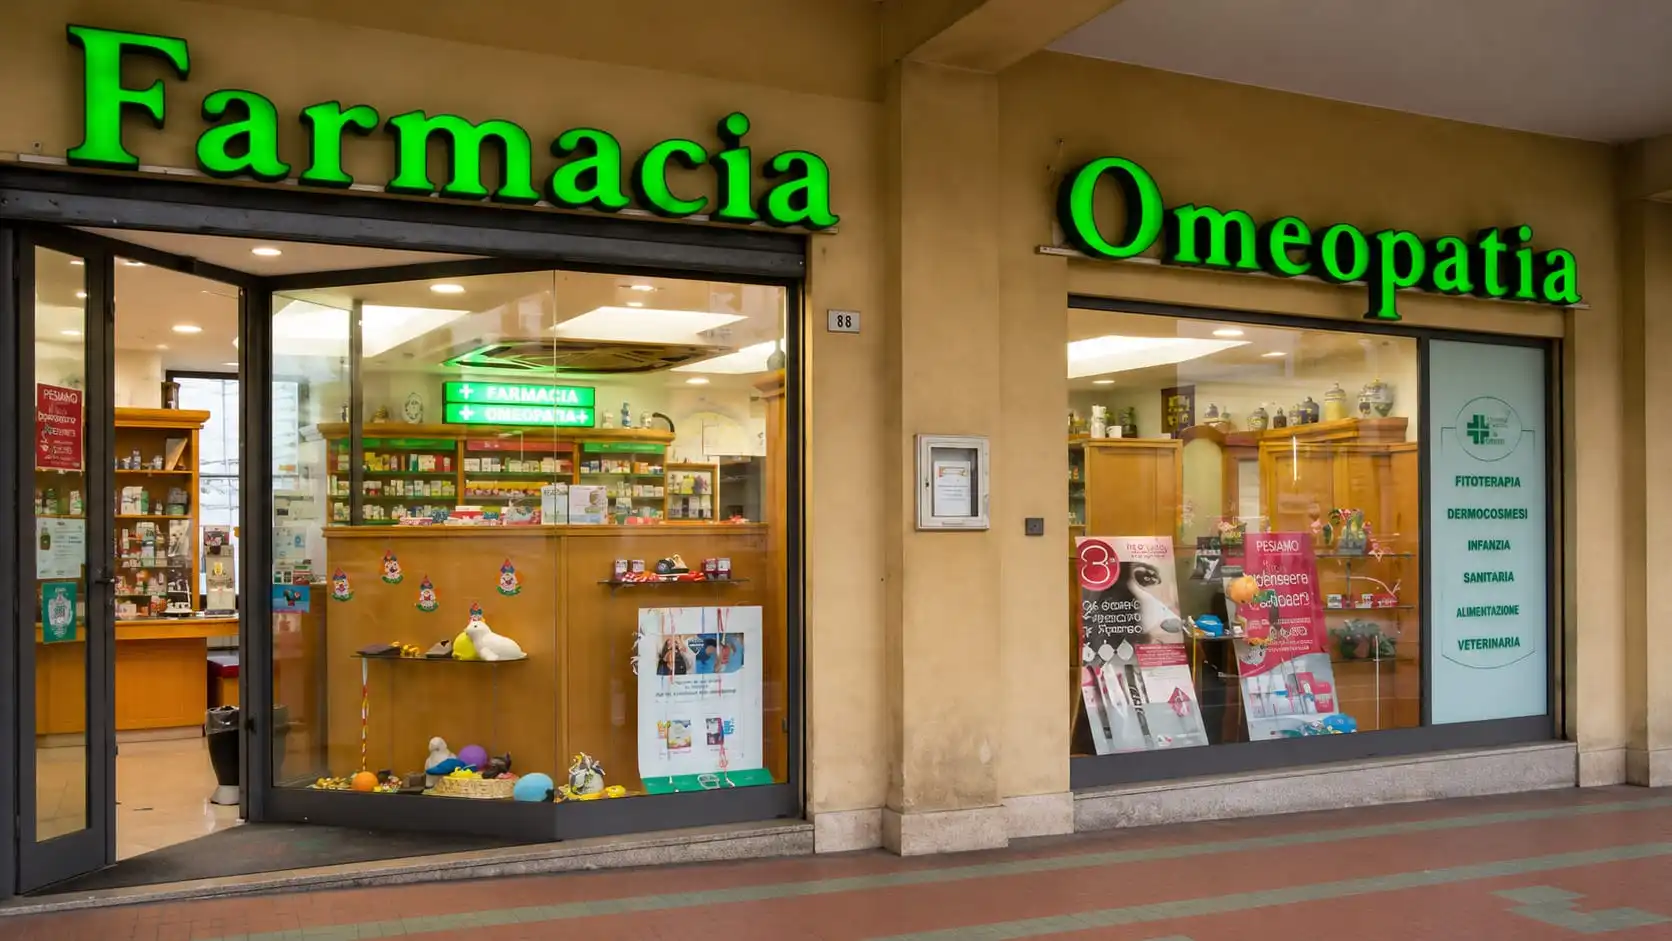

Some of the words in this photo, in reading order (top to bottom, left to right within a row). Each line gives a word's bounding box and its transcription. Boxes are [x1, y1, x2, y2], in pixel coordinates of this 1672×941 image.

[68, 25, 839, 229] Farmacia
[1062, 156, 1582, 320] Omeopatia
[836, 314, 852, 328] 88
[487, 387, 579, 403] FARMACIA
[485, 407, 576, 422] OMEOPATIA
[1455, 475, 1521, 488] FITOTERAPIA
[1447, 508, 1528, 520] DERMOCOSMESI
[1256, 540, 1300, 552] PESIAMO
[1467, 539, 1511, 552] INFANZIA
[1463, 571, 1515, 584] SANITARIA
[1456, 604, 1520, 618] ALIMENTAZIONE
[1457, 636, 1521, 651] VETERINARIA
